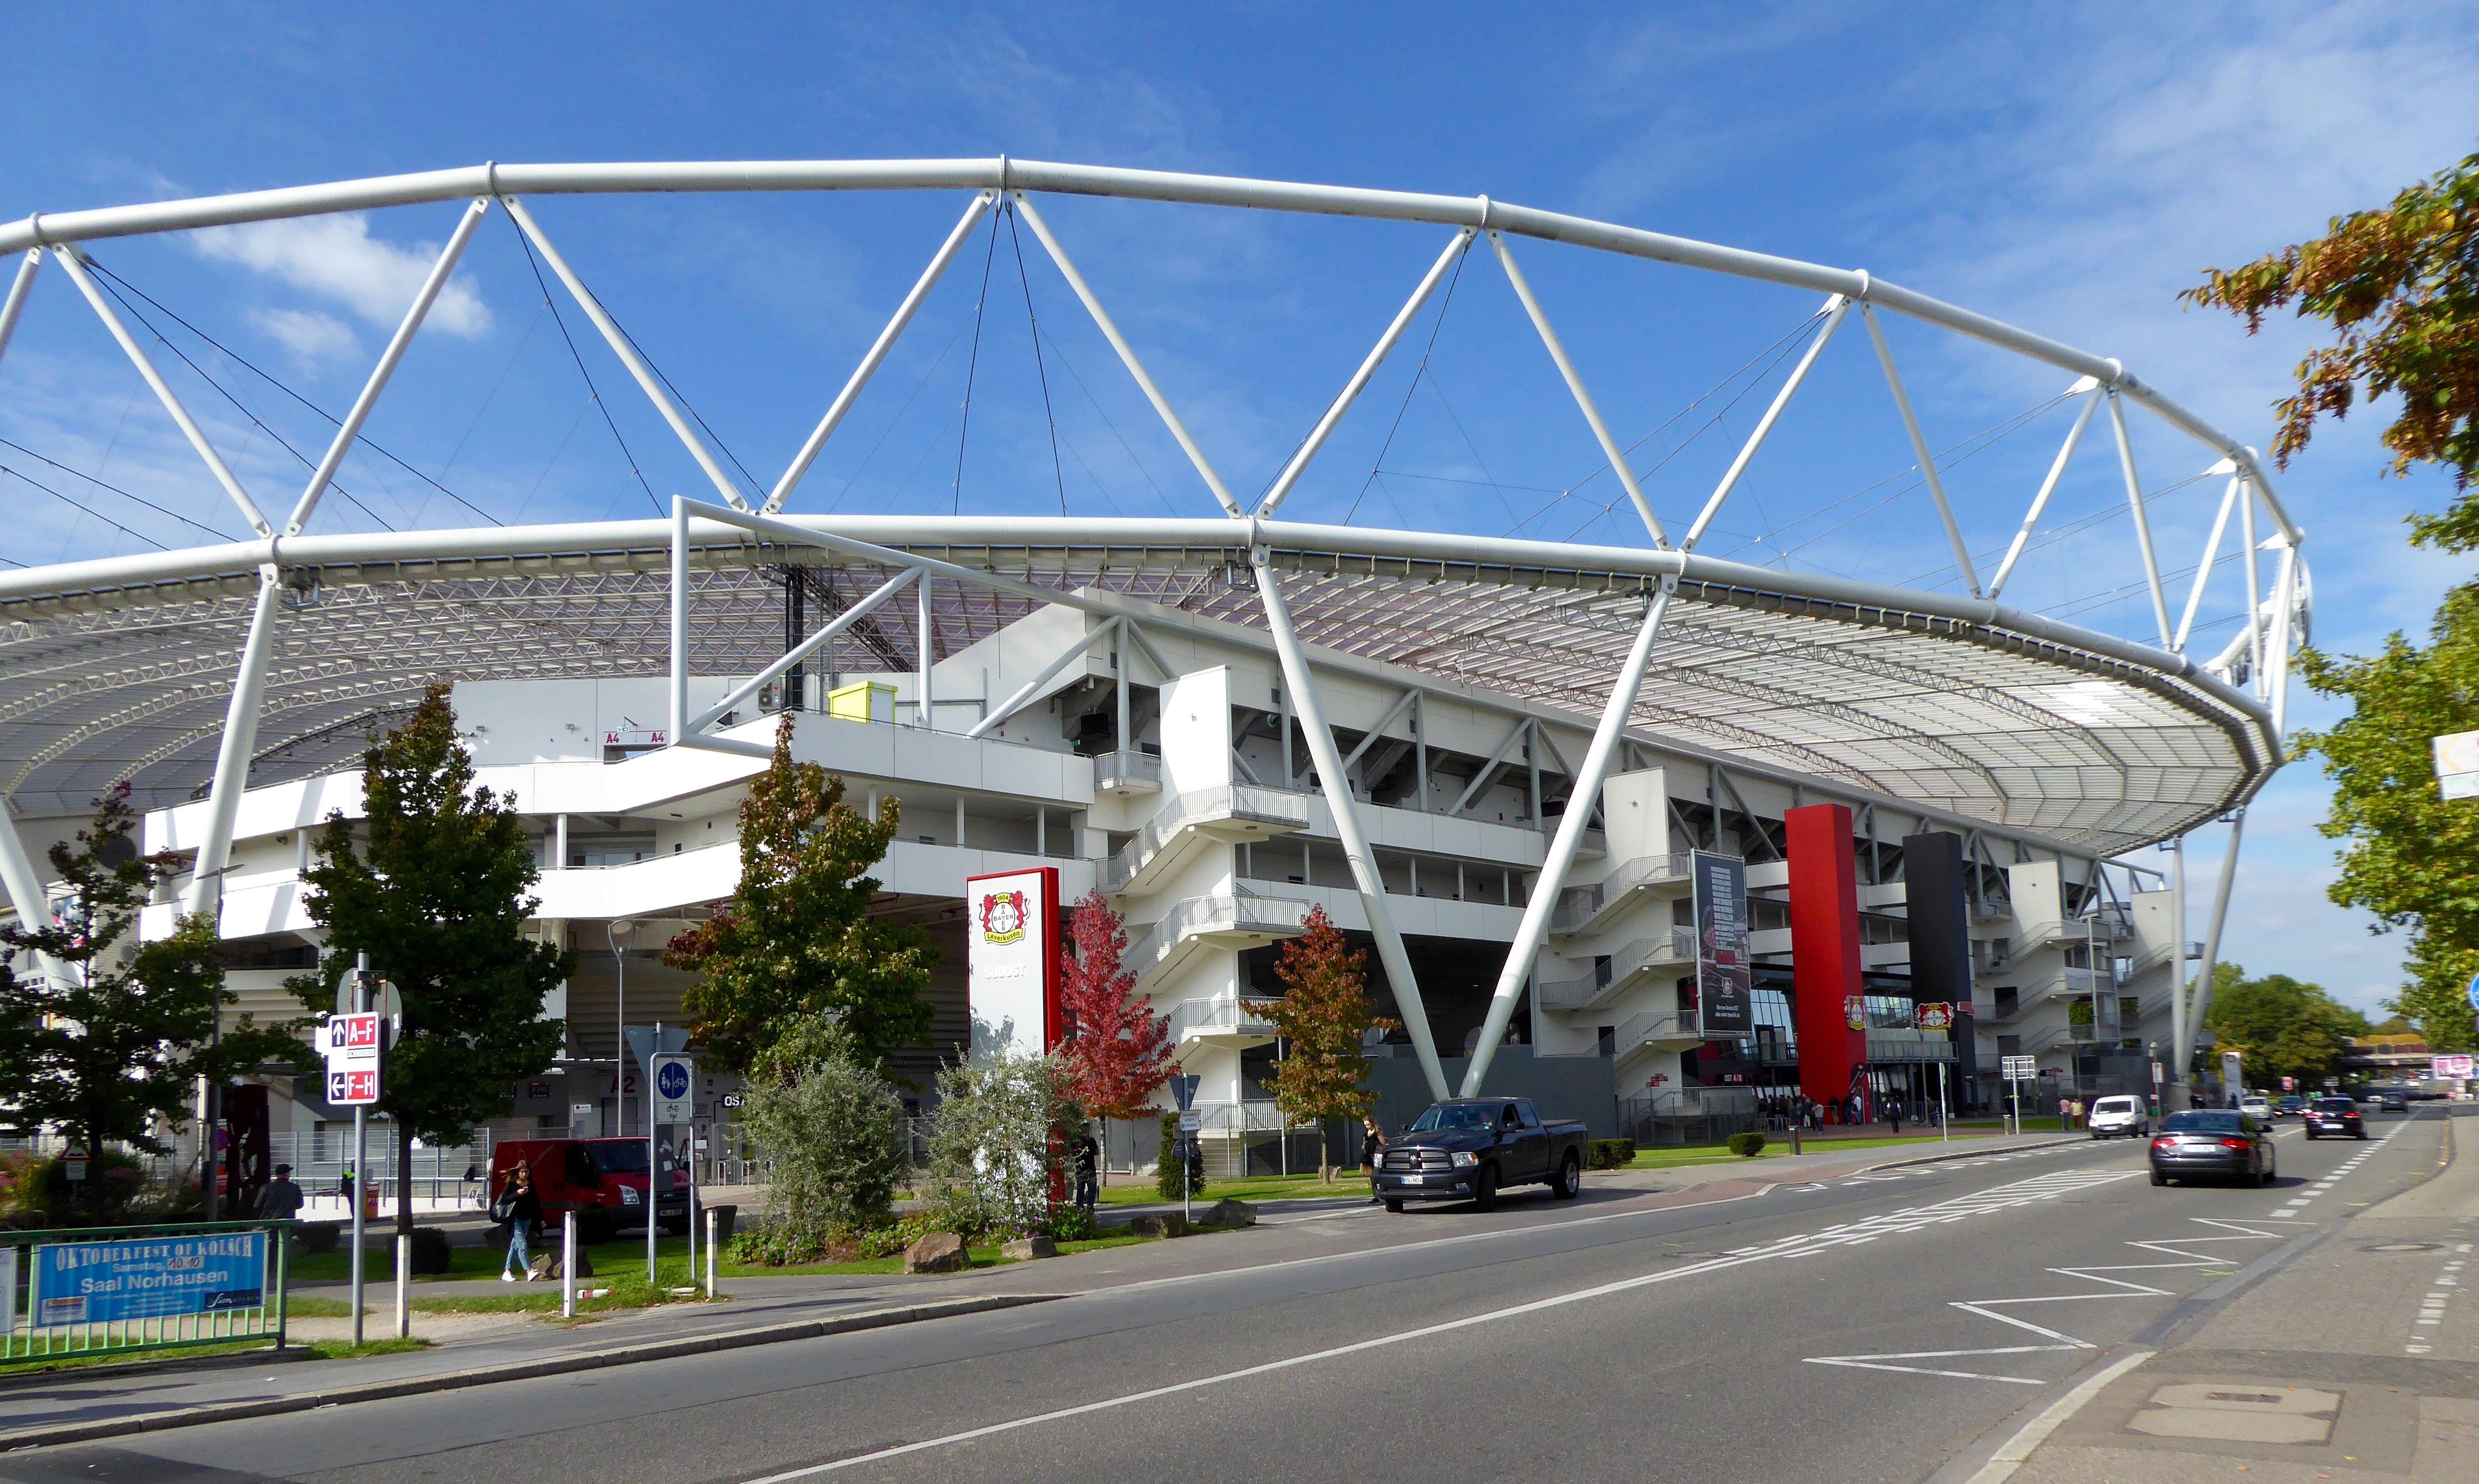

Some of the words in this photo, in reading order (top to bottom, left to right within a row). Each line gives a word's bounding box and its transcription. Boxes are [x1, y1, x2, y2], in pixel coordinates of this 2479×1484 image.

[607, 733, 620, 743] A4
[651, 732, 664, 742] A4
[987, 931, 1020, 941] Leverkusen
[985, 965, 1026, 979] SÜDOST
[349, 1020, 374, 1042] A-F
[348, 1074, 374, 1096] F-H
[610, 1075, 635, 1094] A2
[56, 1245, 170, 1271] OKTOBERFEST
[81, 1276, 122, 1294] Saal
[128, 1270, 228, 1290] Norhausen
